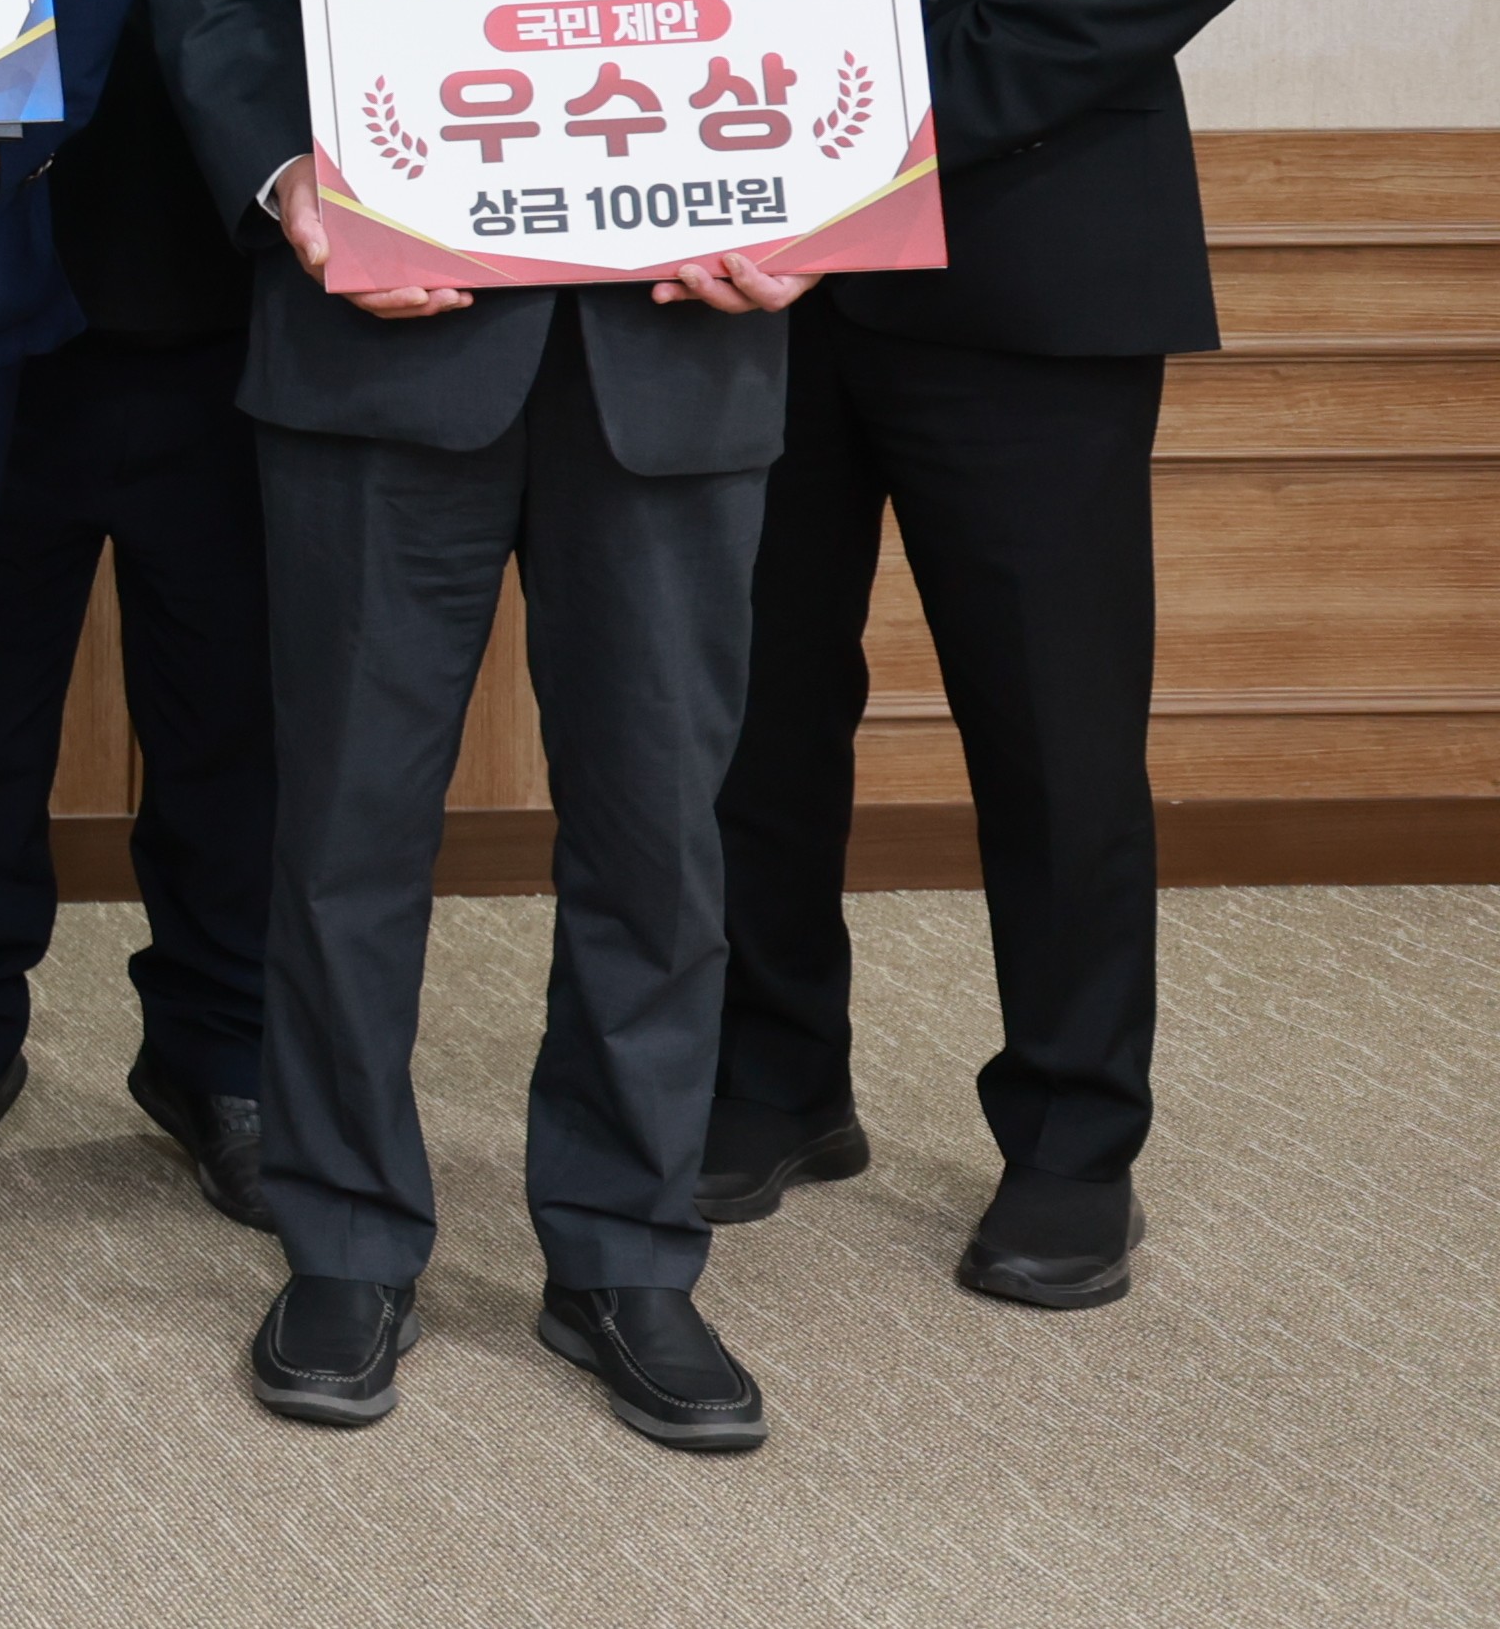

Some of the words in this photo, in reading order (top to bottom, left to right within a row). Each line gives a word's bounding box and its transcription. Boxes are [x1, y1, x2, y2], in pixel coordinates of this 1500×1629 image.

[516, 6, 601, 46] 국민
[611, 0, 699, 41] 제안
[440, 53, 797, 163] 우수상
[470, 188, 568, 236] 상금
[586, 177, 787, 230] 100만원
